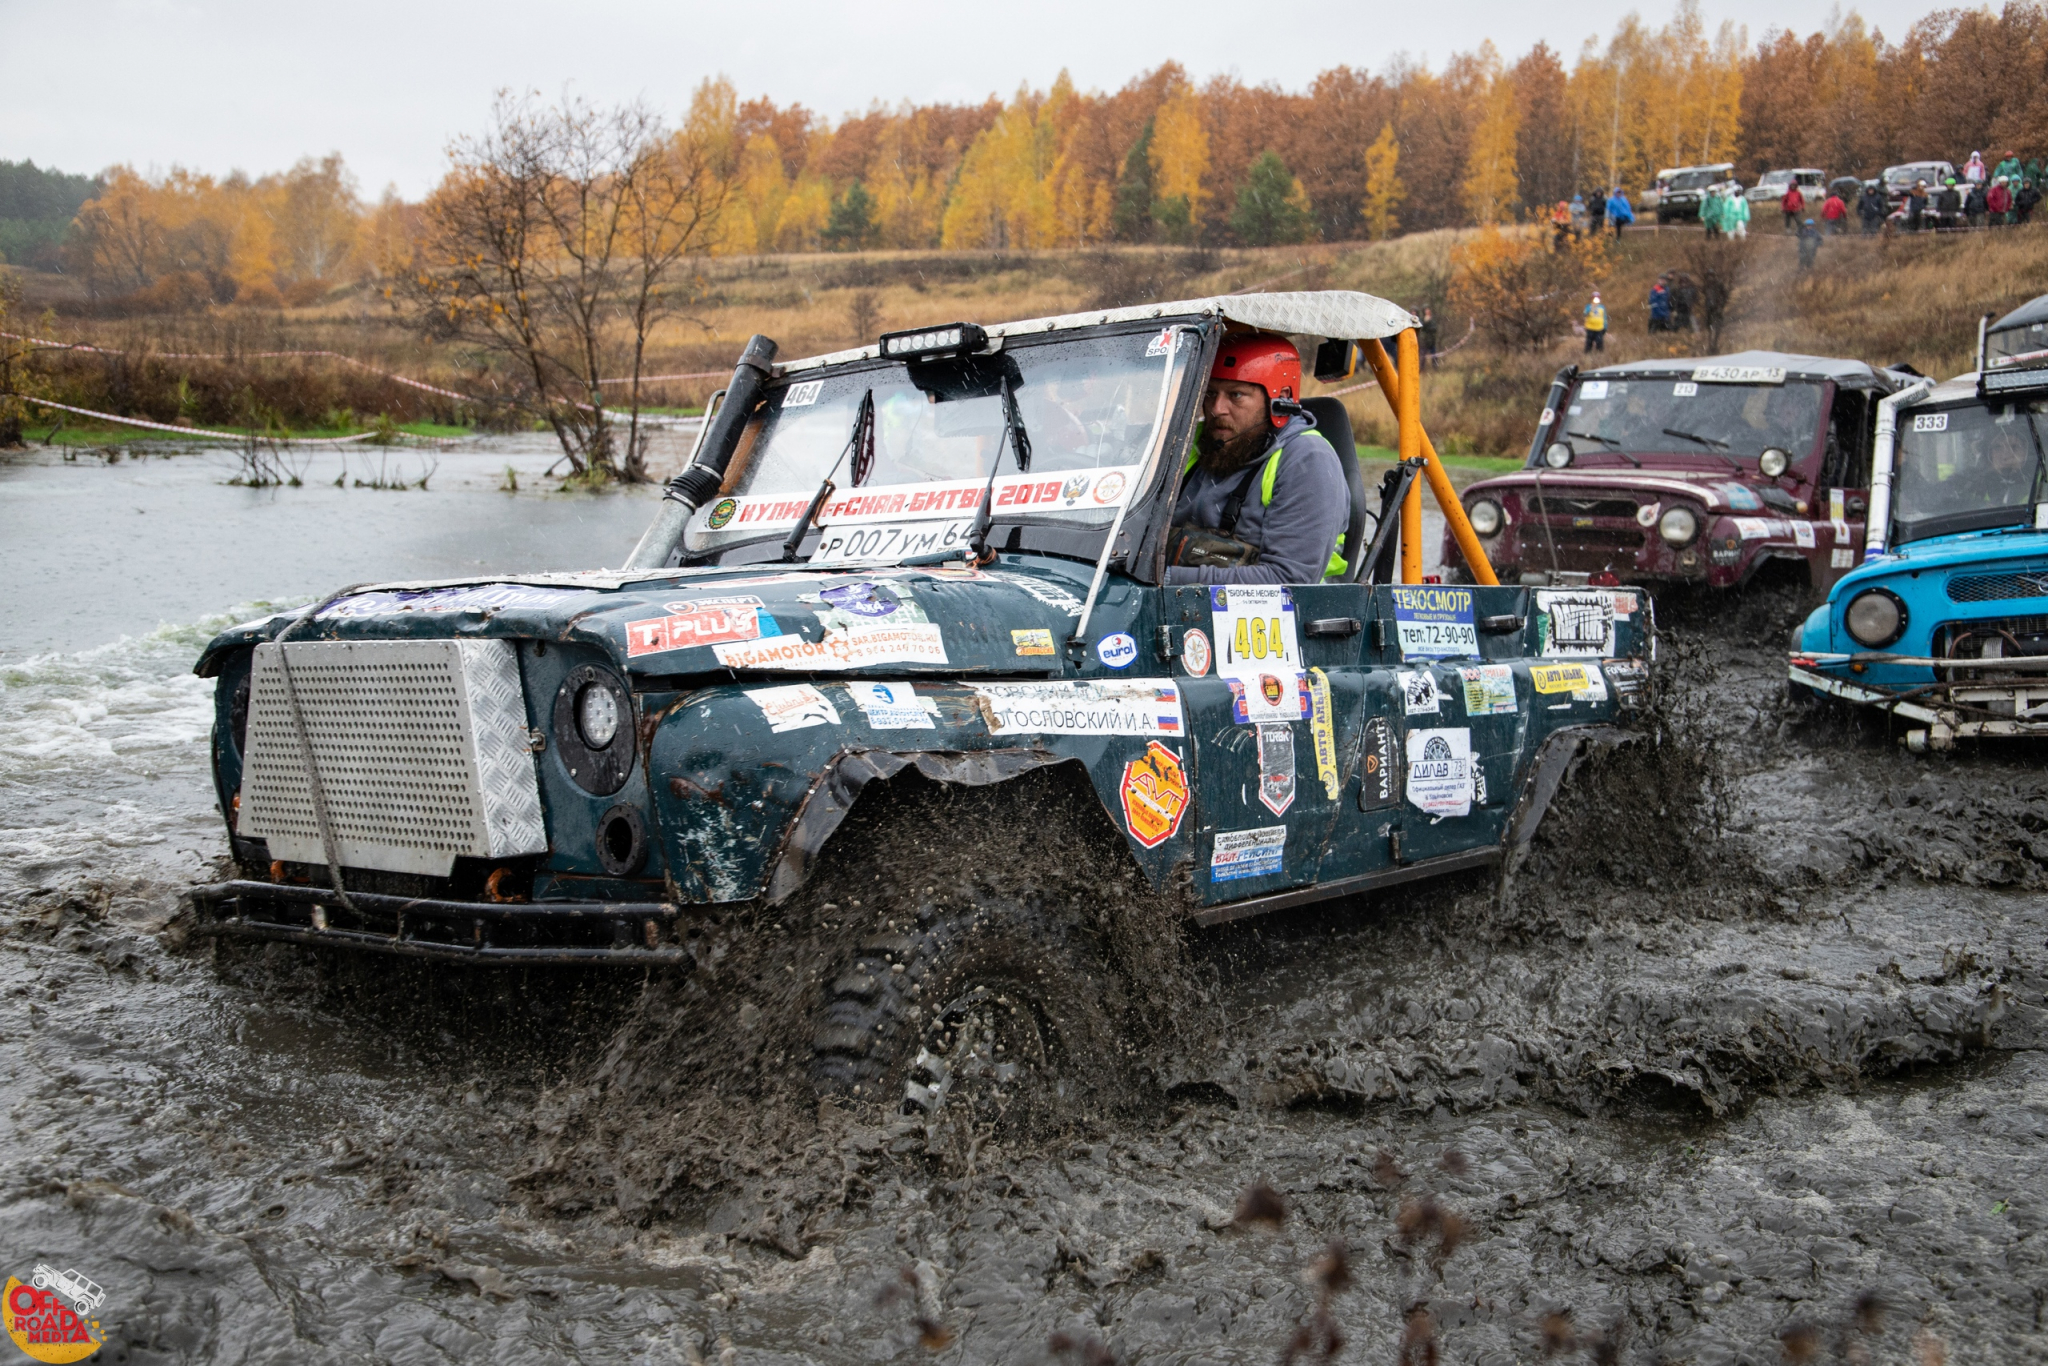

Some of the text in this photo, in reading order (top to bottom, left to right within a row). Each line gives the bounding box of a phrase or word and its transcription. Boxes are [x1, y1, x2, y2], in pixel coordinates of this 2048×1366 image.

[1148, 346, 1169, 356] SPO
[1766, 367, 1781, 378] 13
[786, 383, 820, 405] 464
[1917, 415, 1945, 429] 333
[996, 481, 1063, 507] 2019
[943, 522, 974, 546] 64
[1392, 588, 1471, 613] ТЕХОСМОТР
[1234, 616, 1284, 660] 464
[725, 642, 827, 668] BIGAMOTOR
[1103, 642, 1134, 659] eurol
[1546, 667, 1584, 683] АВТО АЛЬЯНС
[1317, 729, 1329, 766] АВТО
[1377, 724, 1389, 799] ВАРИАНТ
